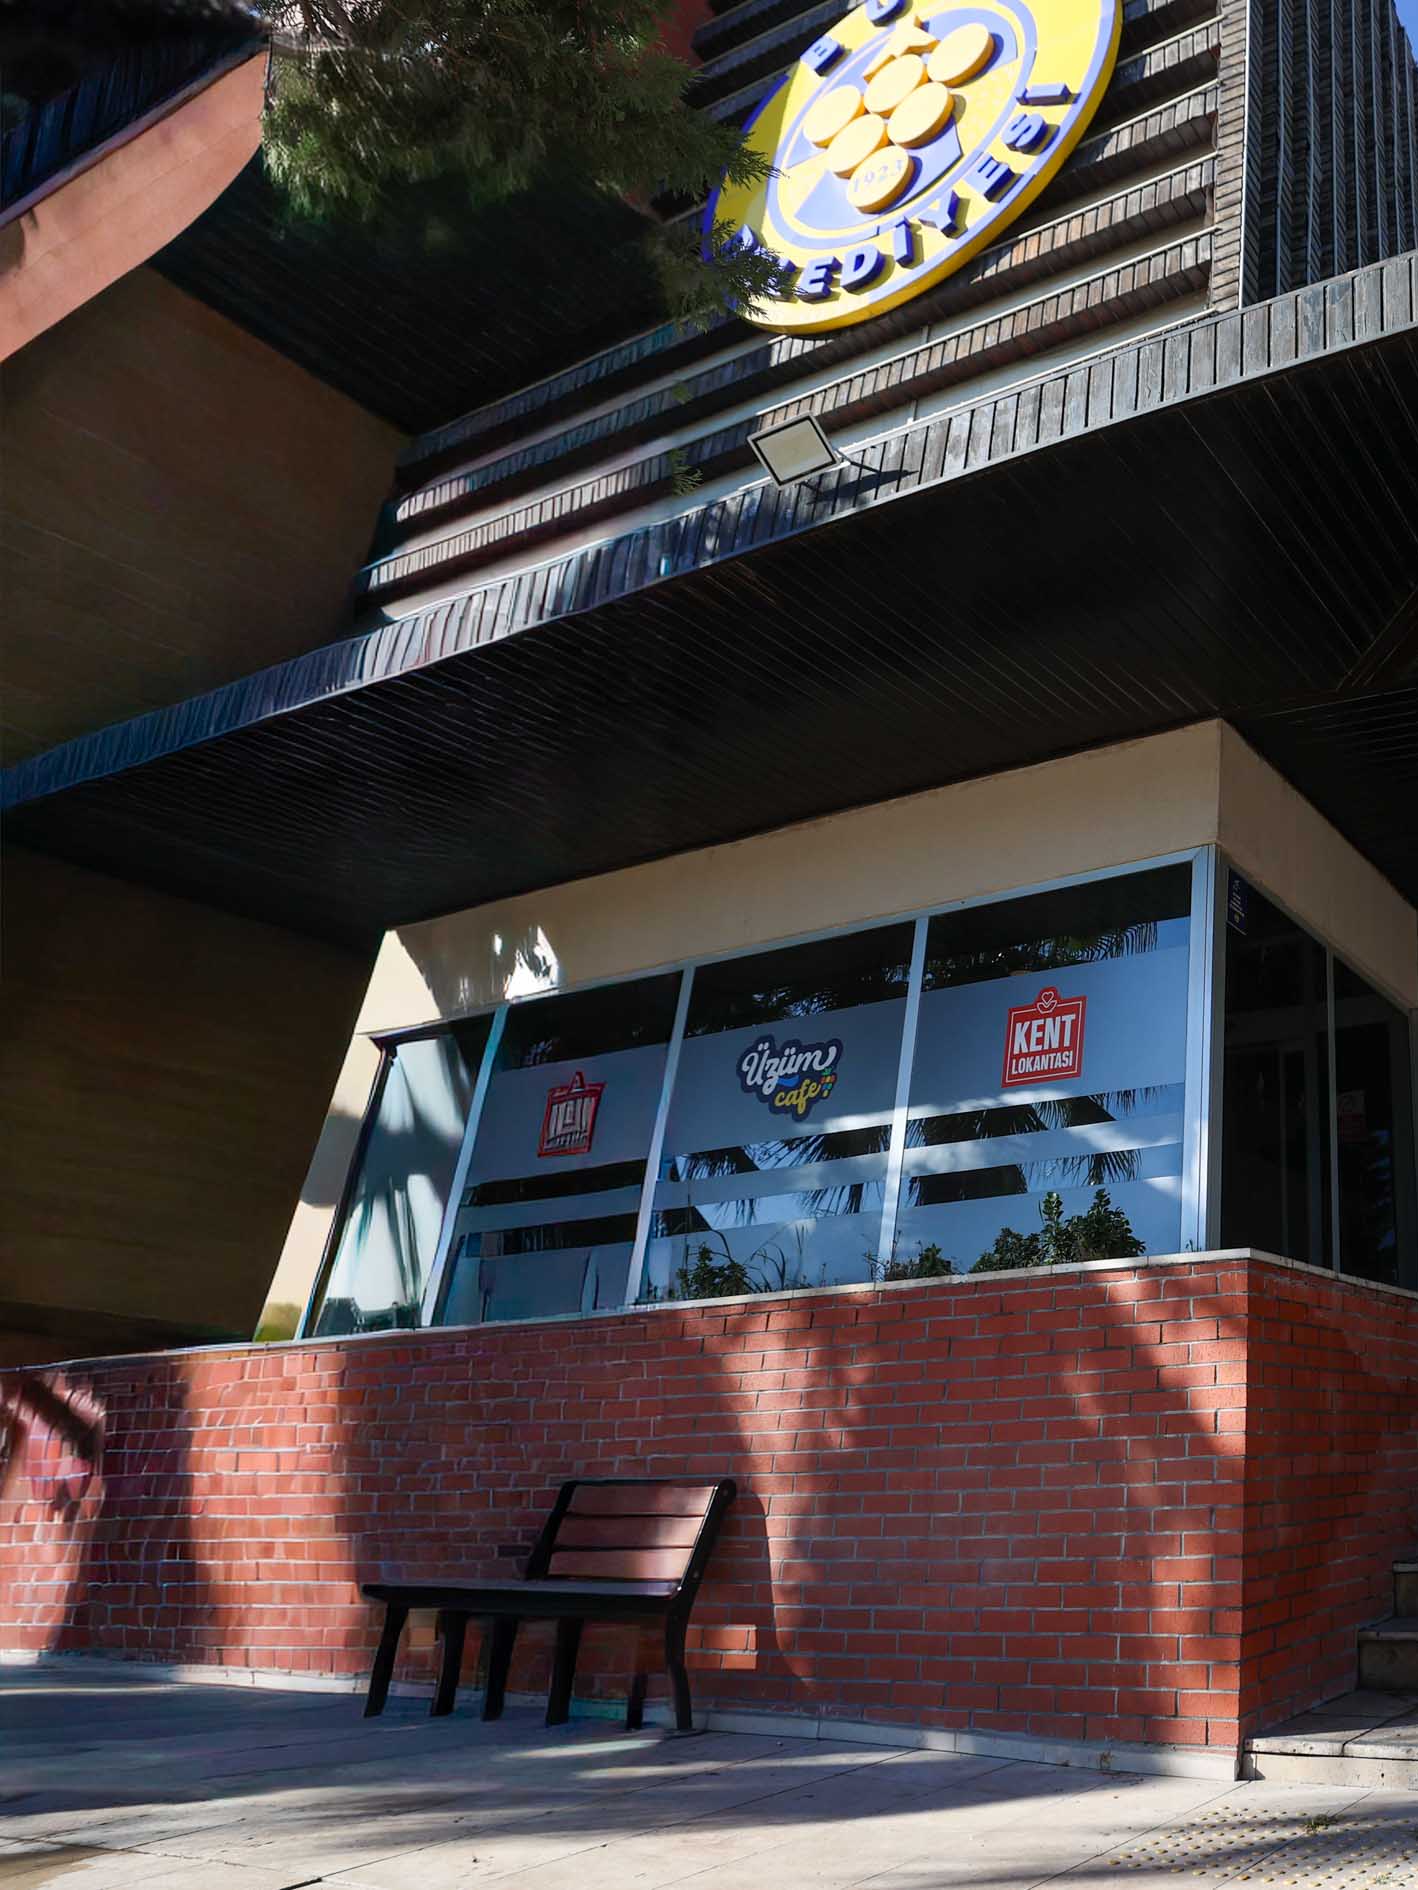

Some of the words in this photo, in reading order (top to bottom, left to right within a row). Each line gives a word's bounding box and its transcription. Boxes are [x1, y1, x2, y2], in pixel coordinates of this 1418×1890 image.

[1013, 1014, 1076, 1055] KENT
[742, 1042, 837, 1095] Üzüm
[1011, 1051, 1073, 1075] LOKANTASI
[774, 1079, 821, 1114] cafe
